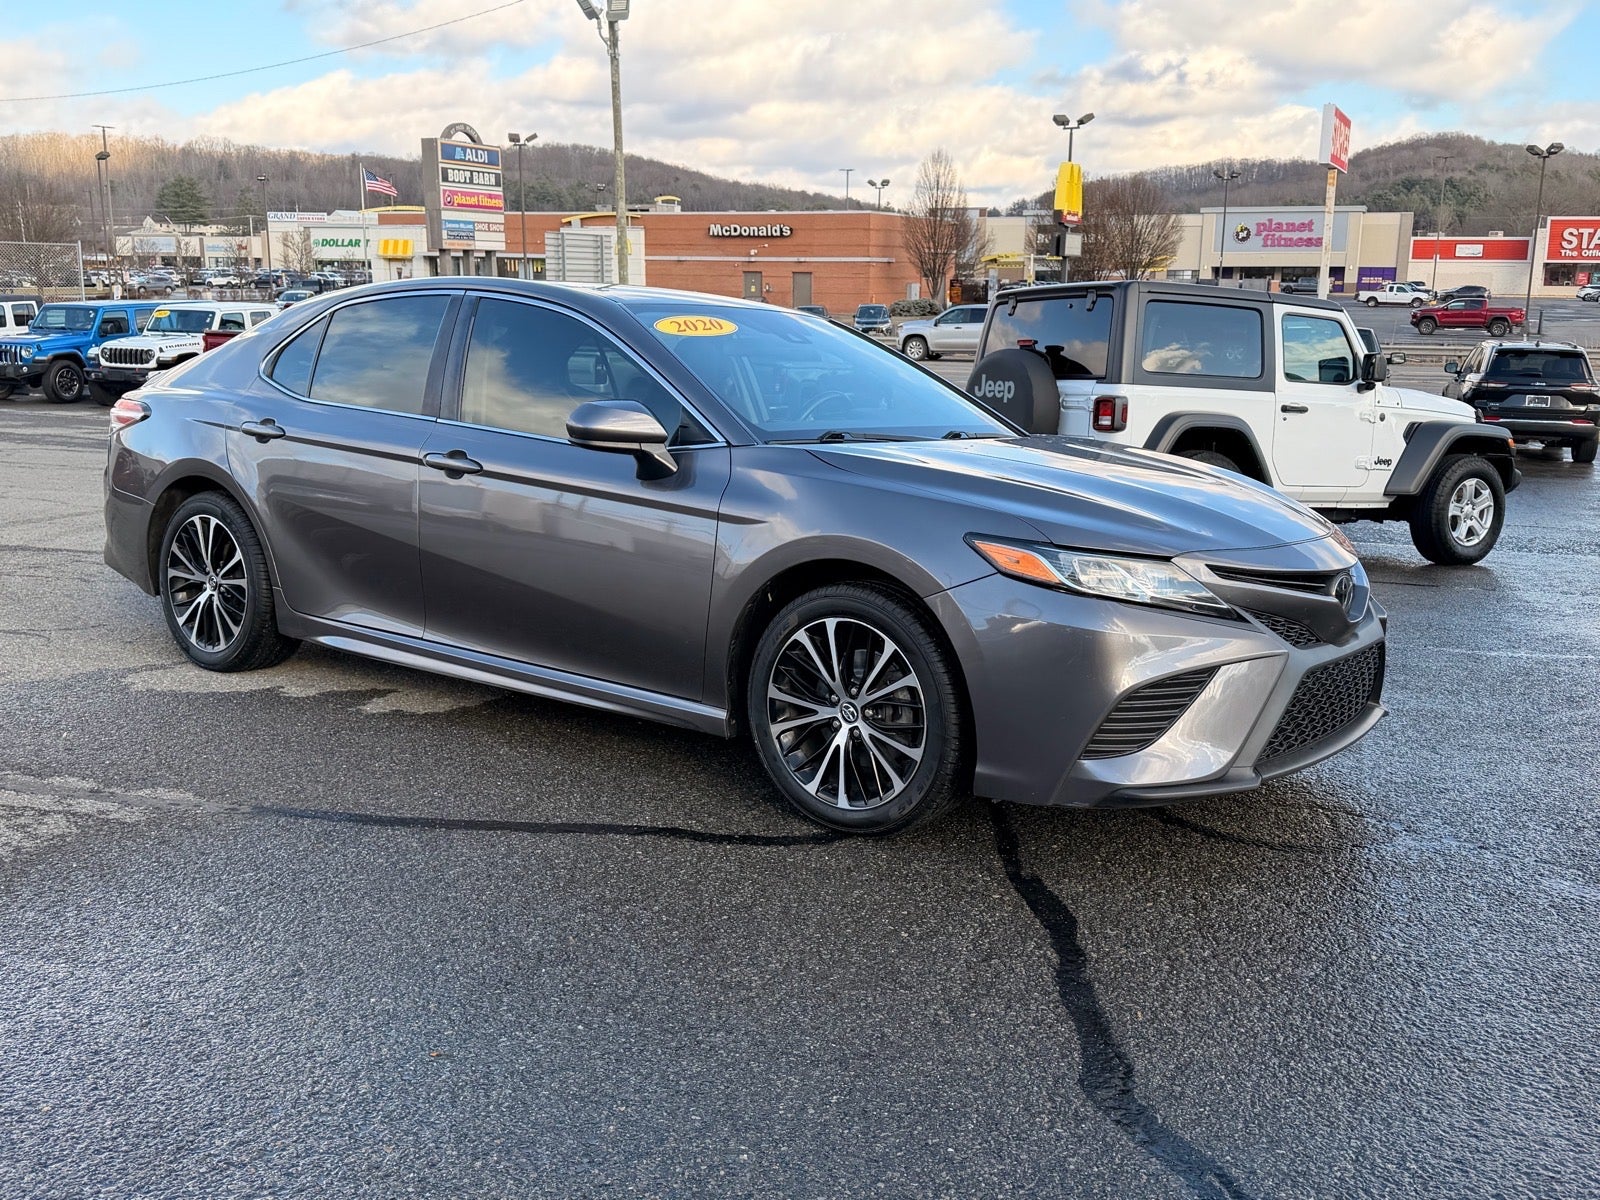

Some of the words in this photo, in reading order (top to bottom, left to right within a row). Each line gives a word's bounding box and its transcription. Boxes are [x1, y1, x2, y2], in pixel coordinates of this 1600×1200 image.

[465, 148, 488, 163] ALDI
[447, 169, 471, 183] BOOT
[472, 171, 496, 186] BARN
[454, 193, 478, 207] planet
[479, 194, 503, 208] fitness
[474, 222, 489, 231] SHOE
[489, 223, 504, 232] SHOW
[709, 223, 791, 236] McDonald's
[1255, 218, 1315, 236] planet
[321, 238, 361, 247] DOLLAR
[1261, 233, 1323, 248] fitness
[1561, 227, 1600, 249] STA
[1560, 249, 1578, 257] The
[669, 318, 724, 333] 2020
[974, 374, 1015, 403] Jeep
[1374, 456, 1393, 468] Jeep
